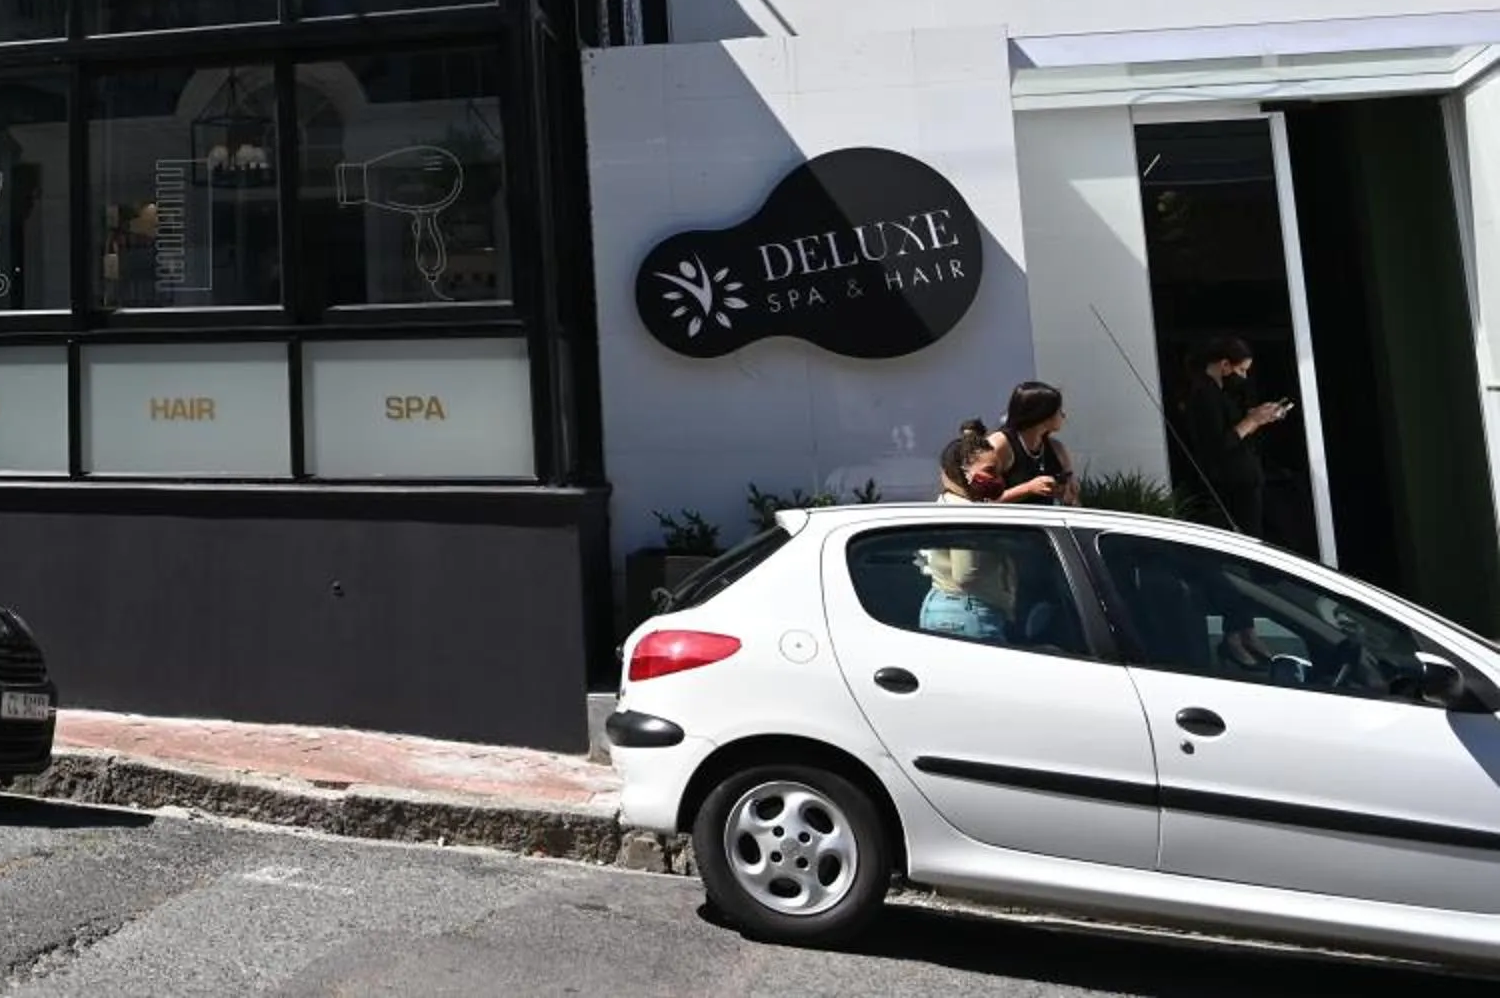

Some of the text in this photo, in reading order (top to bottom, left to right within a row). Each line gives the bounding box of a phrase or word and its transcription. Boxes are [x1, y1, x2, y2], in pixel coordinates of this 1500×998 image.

[758, 208, 960, 282] DELUXE
[766, 258, 966, 314] SPA & HAIR
[150, 398, 216, 421] HAIR
[385, 396, 445, 420] SPA
